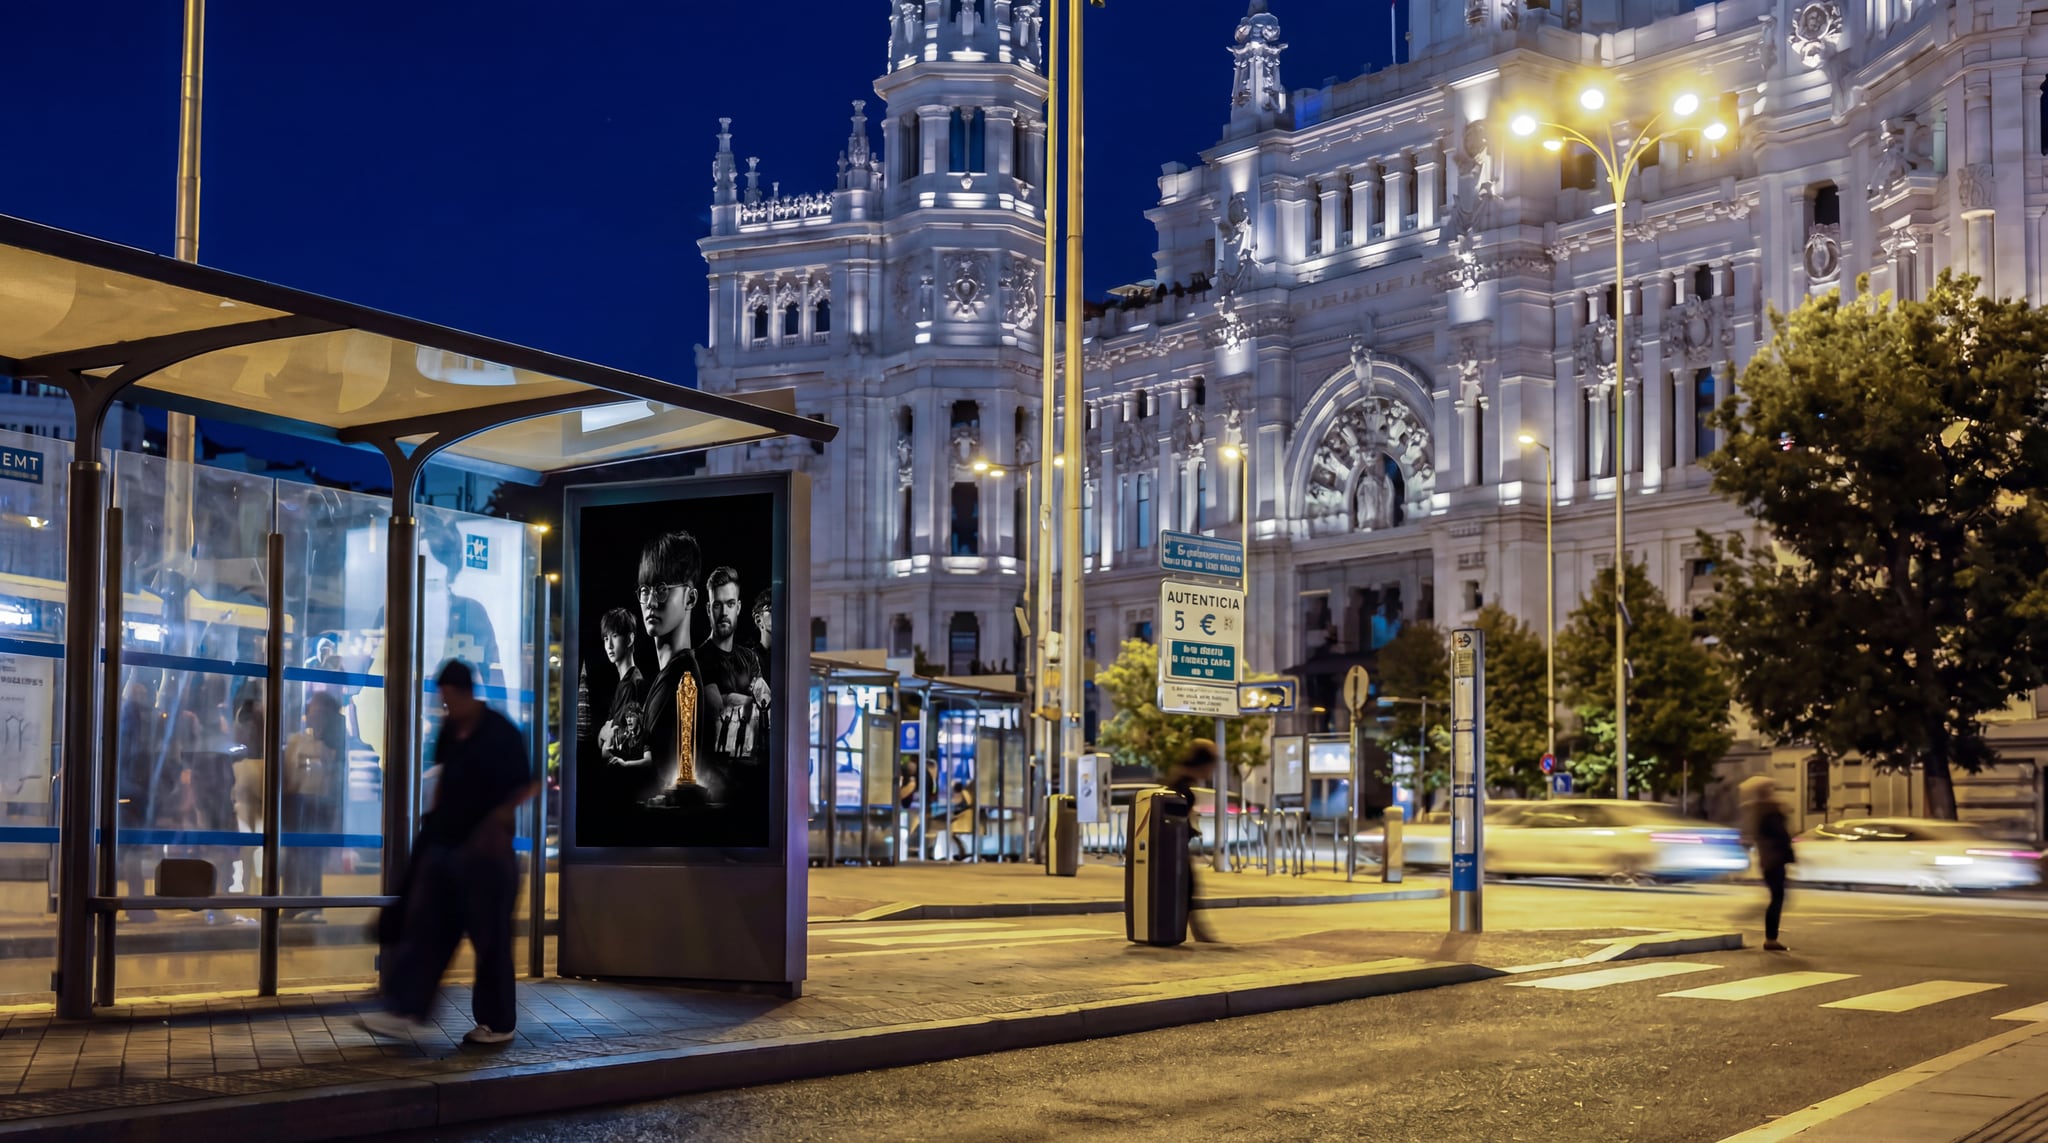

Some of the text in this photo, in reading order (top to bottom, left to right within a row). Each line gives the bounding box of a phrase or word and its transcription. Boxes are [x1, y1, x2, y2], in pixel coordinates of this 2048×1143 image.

[3, 452, 39, 471] EMT
[1167, 590, 1240, 610] AUTENTICIA
[1174, 610, 1185, 631] 5
[1199, 613, 1217, 636] €
